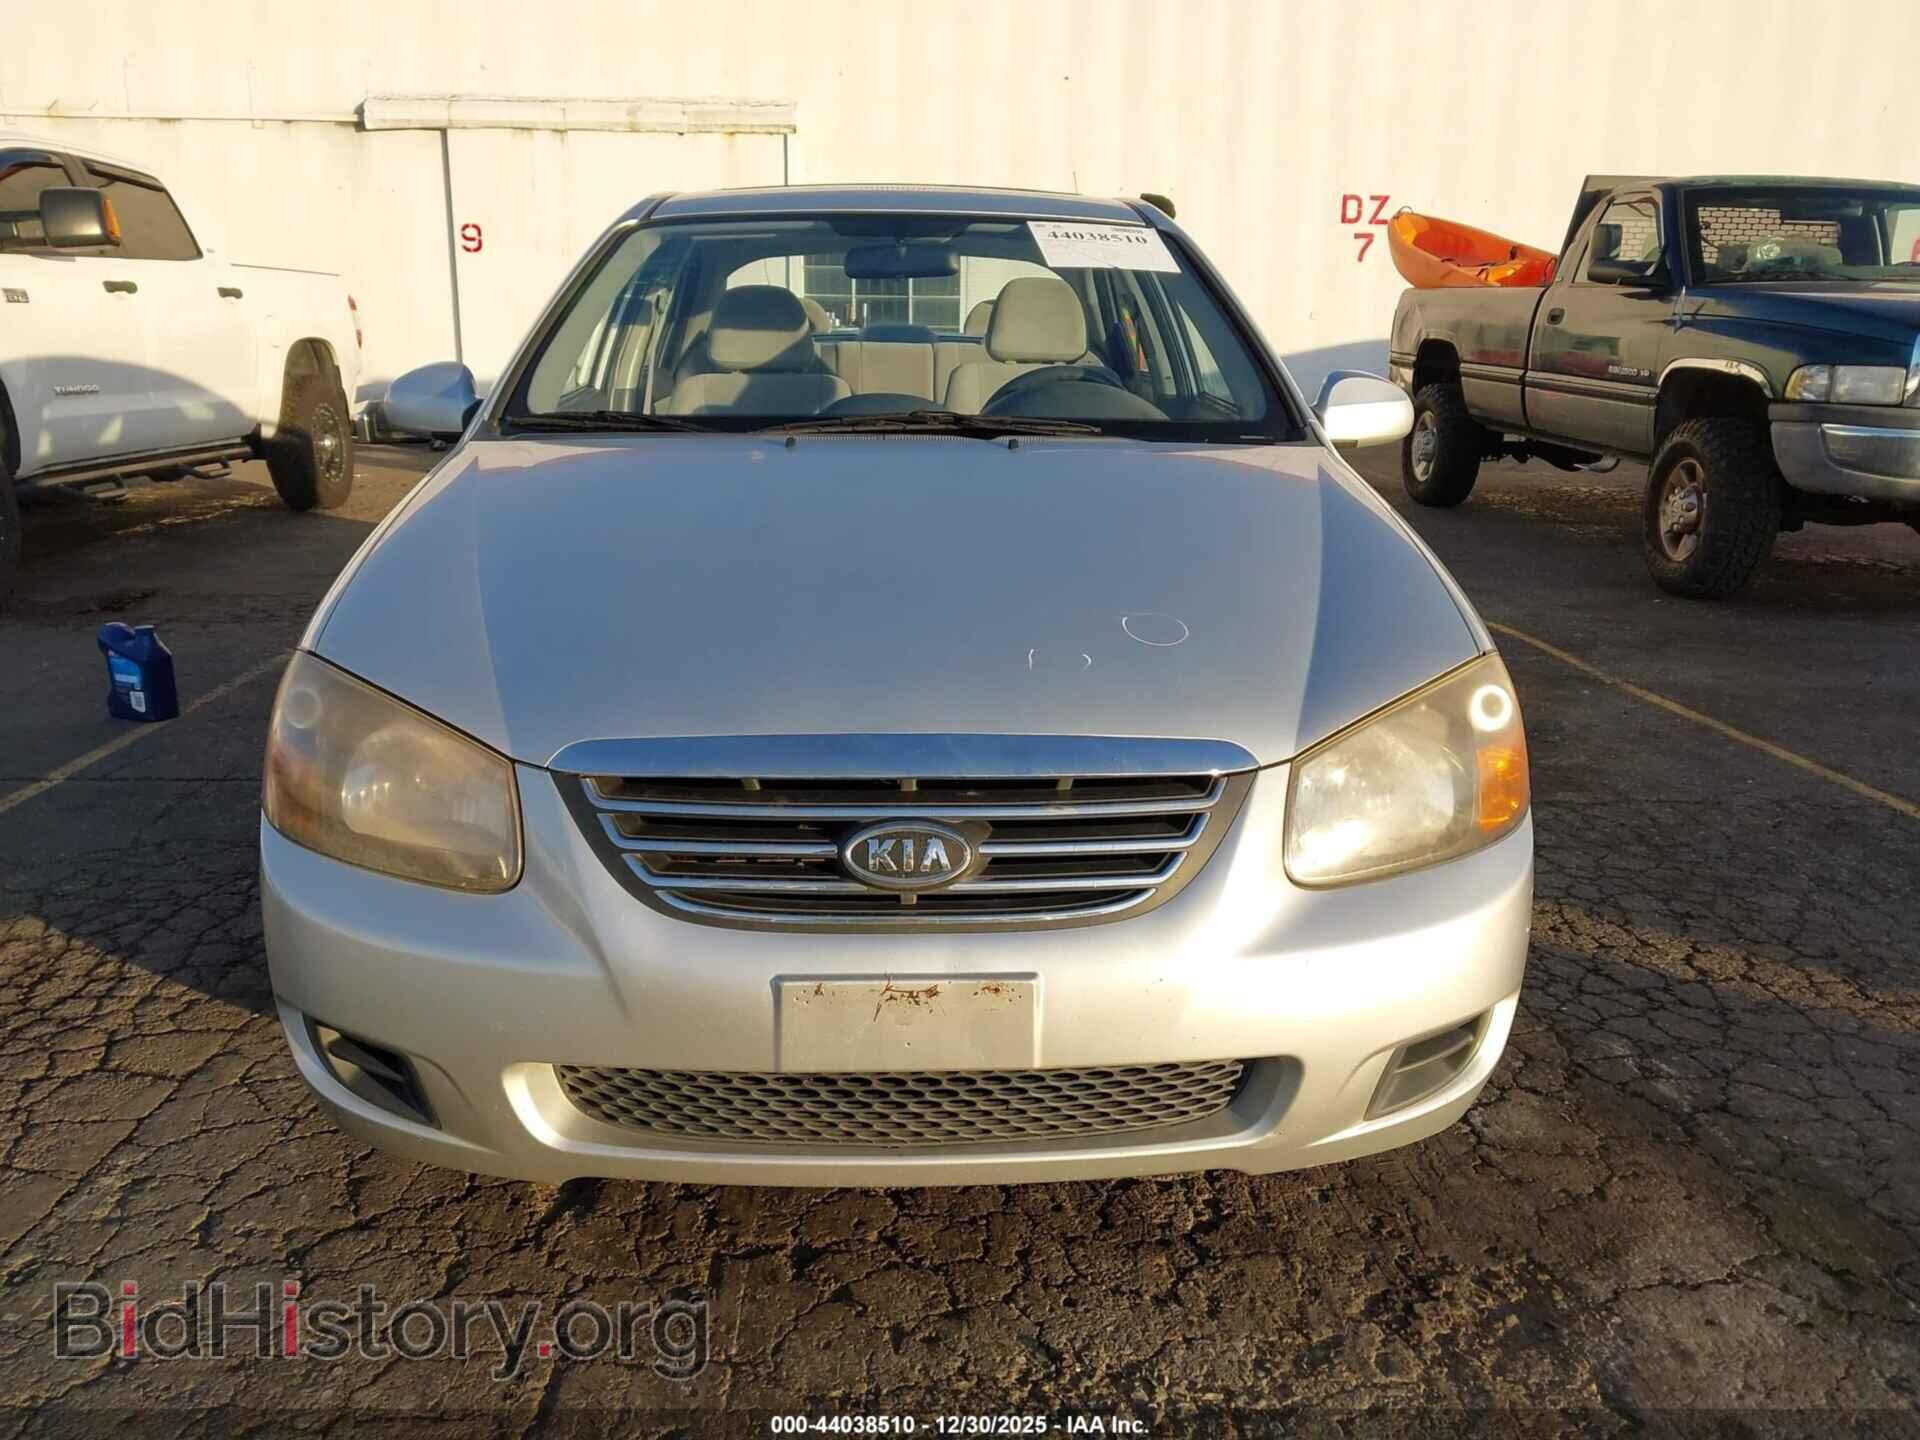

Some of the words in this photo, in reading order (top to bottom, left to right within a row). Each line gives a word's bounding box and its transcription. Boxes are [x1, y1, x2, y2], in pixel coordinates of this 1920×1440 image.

[1341, 194, 1390, 224] DZ
[461, 223, 483, 253] 9
[1047, 230, 1148, 245] 44038510
[1353, 233, 1374, 262] 7
[866, 836, 951, 872] KIA
